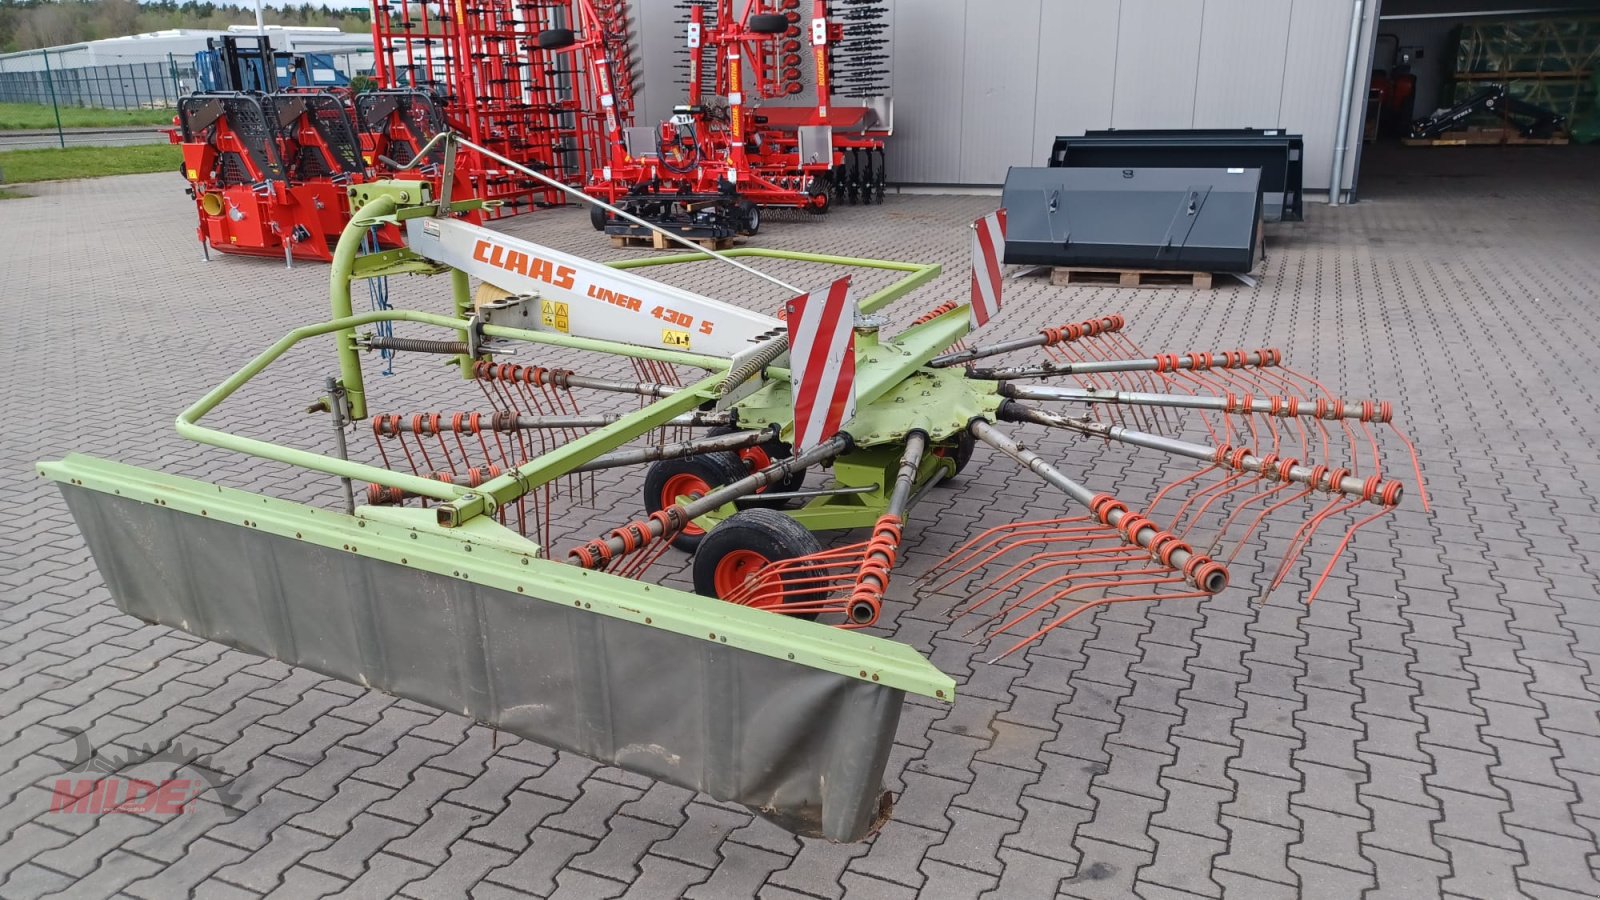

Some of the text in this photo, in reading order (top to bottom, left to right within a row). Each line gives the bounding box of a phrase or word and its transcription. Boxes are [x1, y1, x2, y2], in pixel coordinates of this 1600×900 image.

[730, 62, 738, 91] ROTATION
[473, 240, 714, 335] CLAAS LINER 430 S
